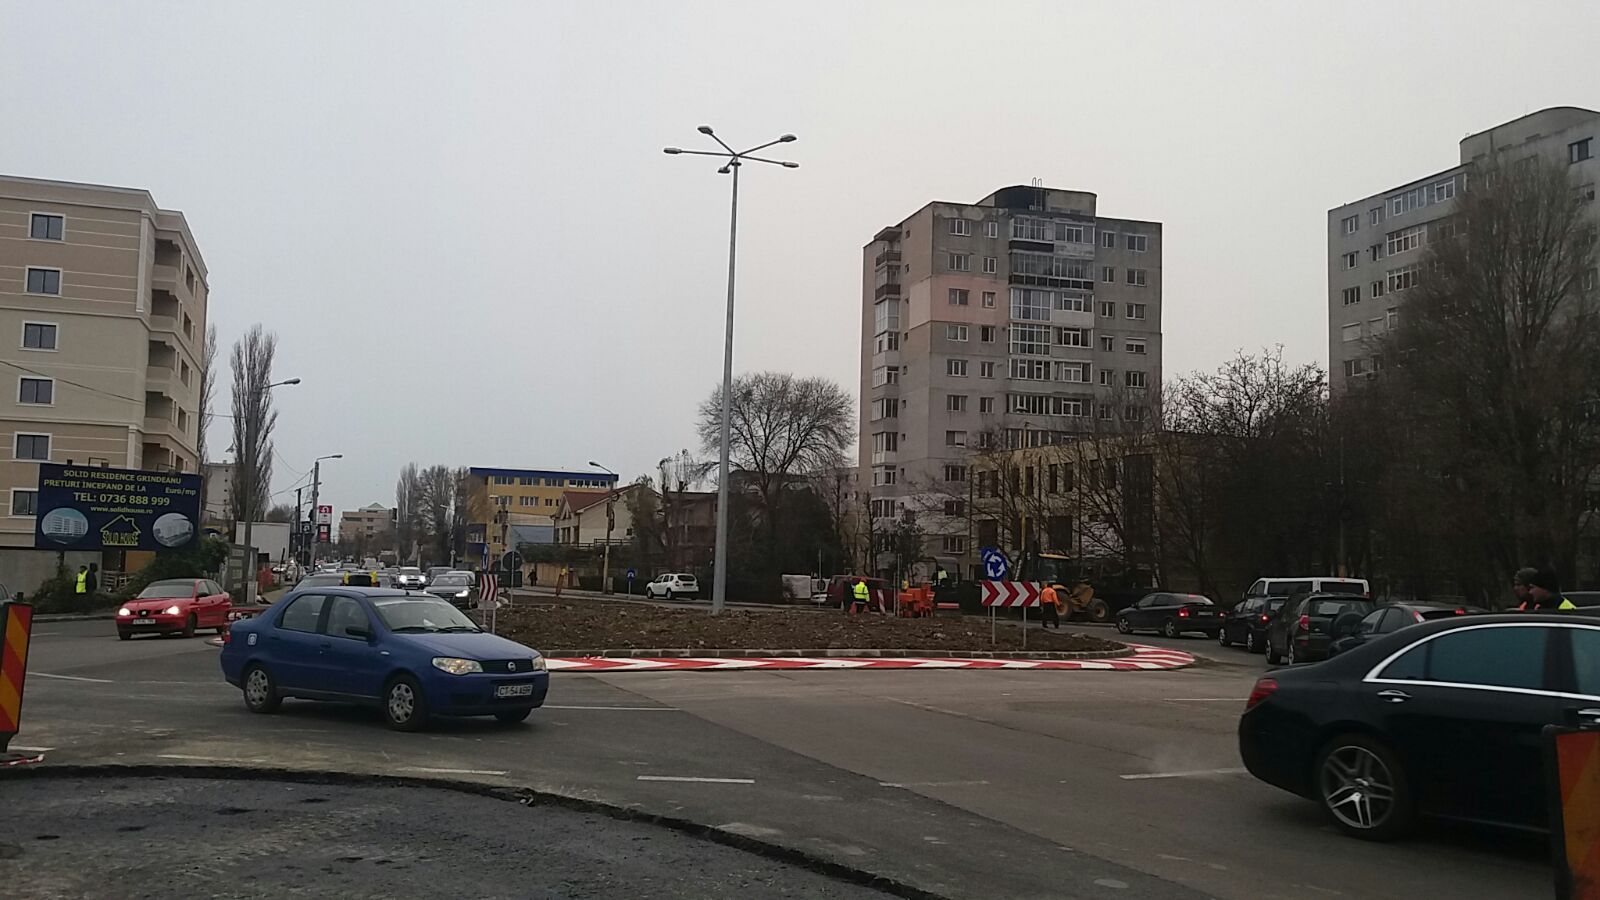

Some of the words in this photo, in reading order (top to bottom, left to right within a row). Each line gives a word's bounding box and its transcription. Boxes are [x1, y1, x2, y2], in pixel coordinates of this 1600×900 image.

[63, 469, 89, 478] SOLID
[90, 471, 136, 481] RESIDENCE
[136, 474, 182, 485] GRINDEANU
[43, 479, 80, 489] PRETURI
[82, 481, 124, 491] INCEPAND
[165, 486, 197, 496] Euro/mp
[73, 491, 97, 502] TEL:
[99, 493, 127, 504] 0736
[129, 495, 149, 505] 888
[151, 496, 170, 506] 999
[90, 506, 154, 514] www.solidhouse.ro
[103, 531, 118, 544] SOLID
[119, 531, 138, 545] HOUSE
